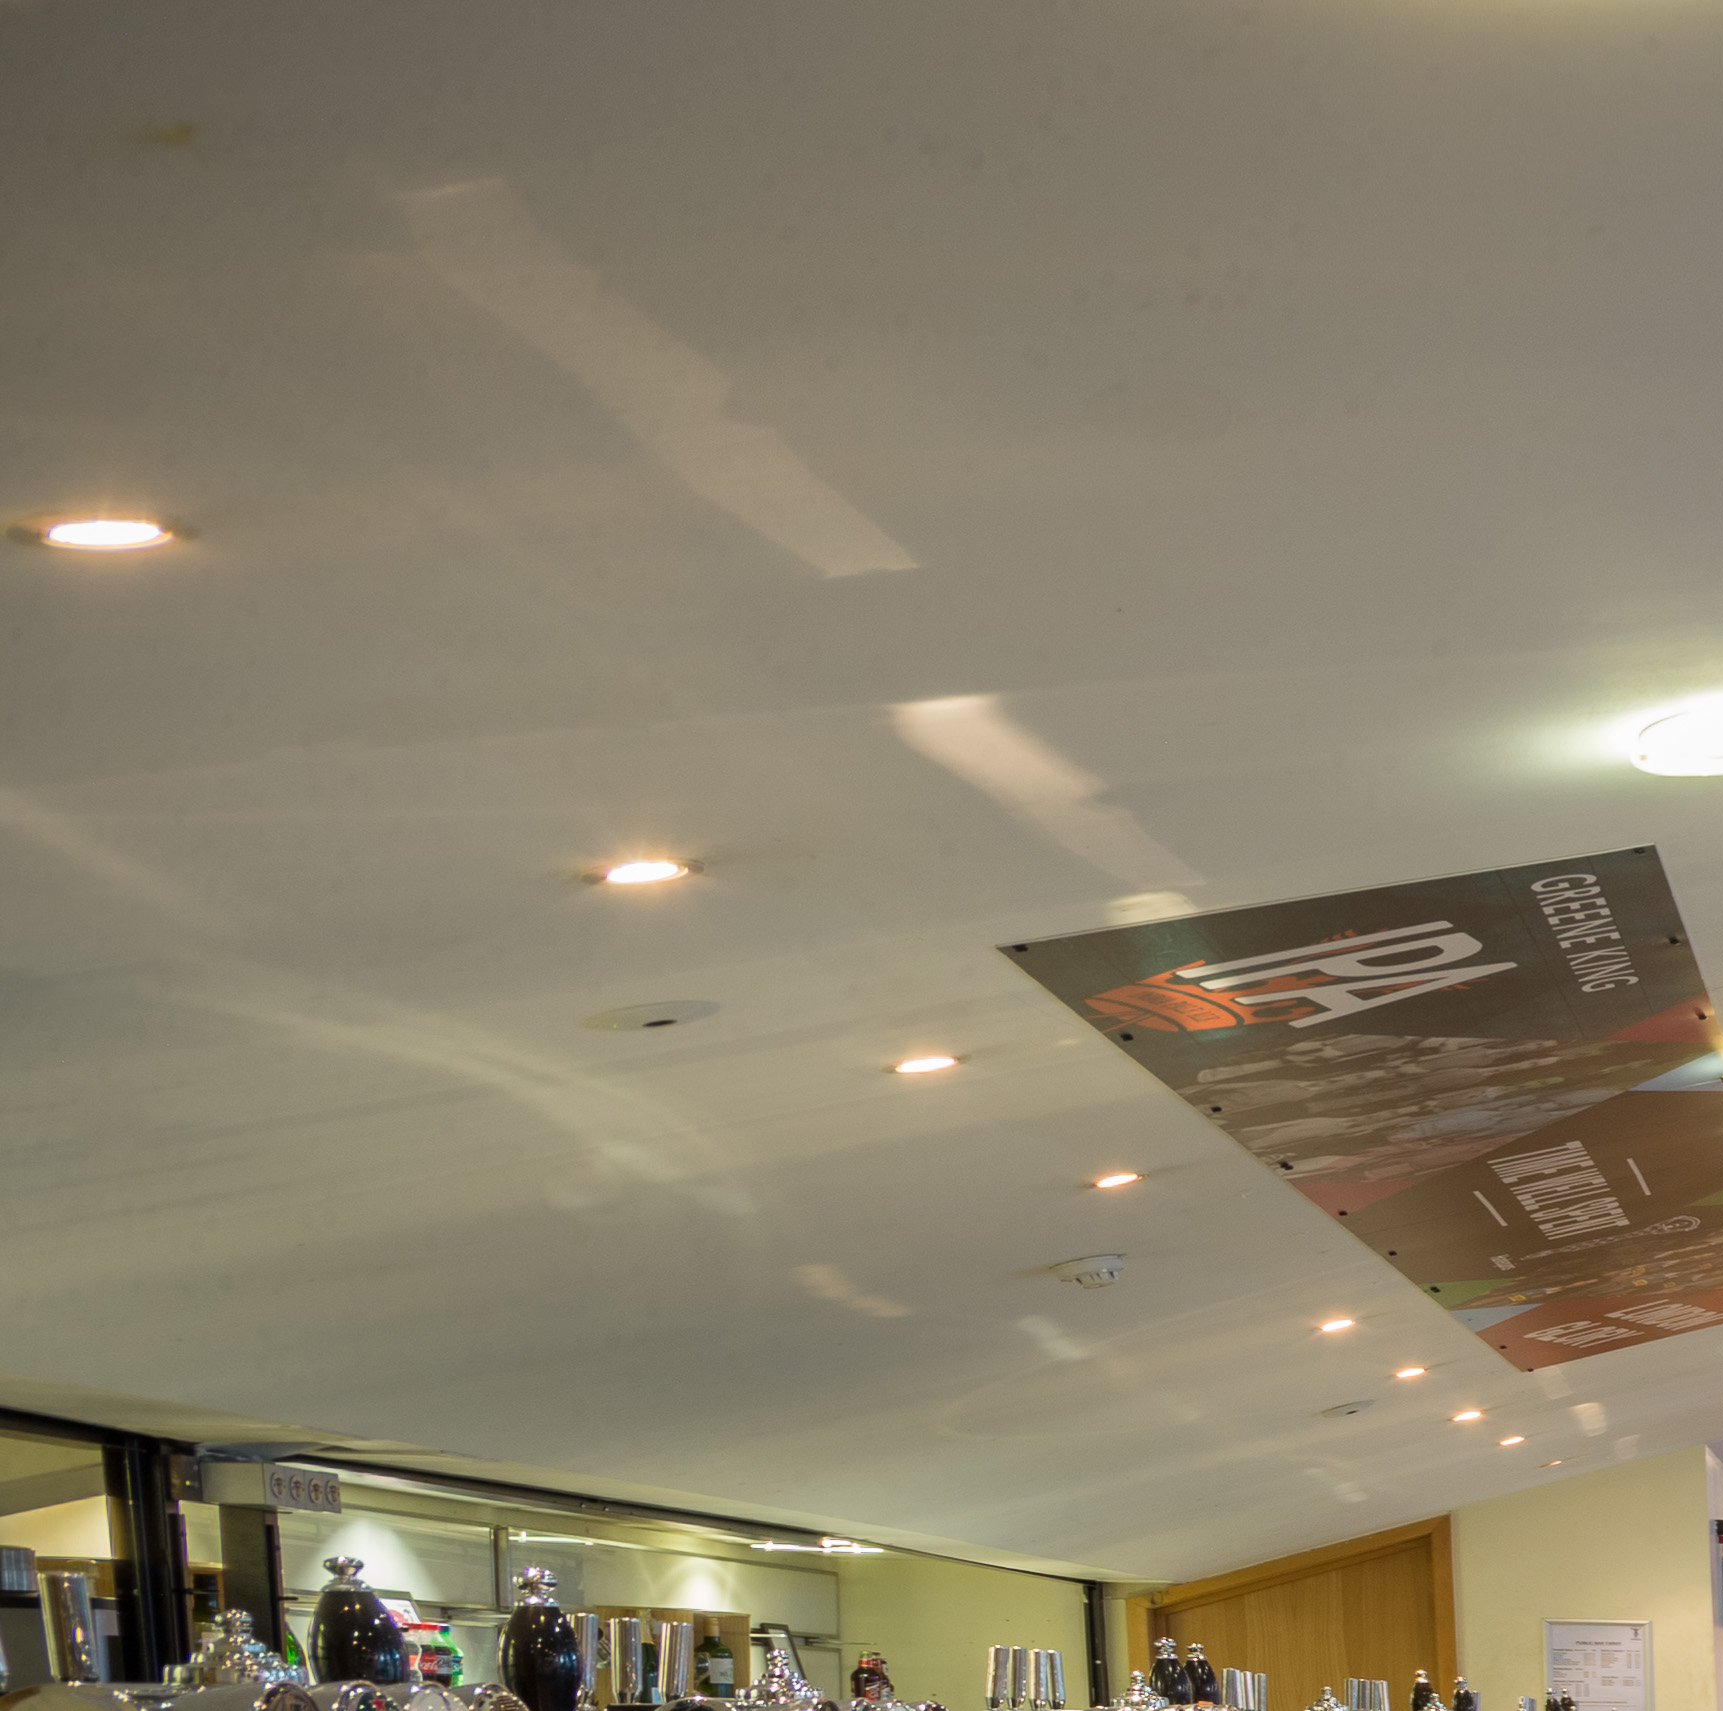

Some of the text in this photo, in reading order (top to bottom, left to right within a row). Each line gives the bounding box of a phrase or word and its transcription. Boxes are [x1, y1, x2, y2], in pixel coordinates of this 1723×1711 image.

[1175, 920, 1518, 1029] IPA
[1531, 873, 1639, 993] GREENE KING
[1486, 1140, 1631, 1240] TIME WELL SPENT
